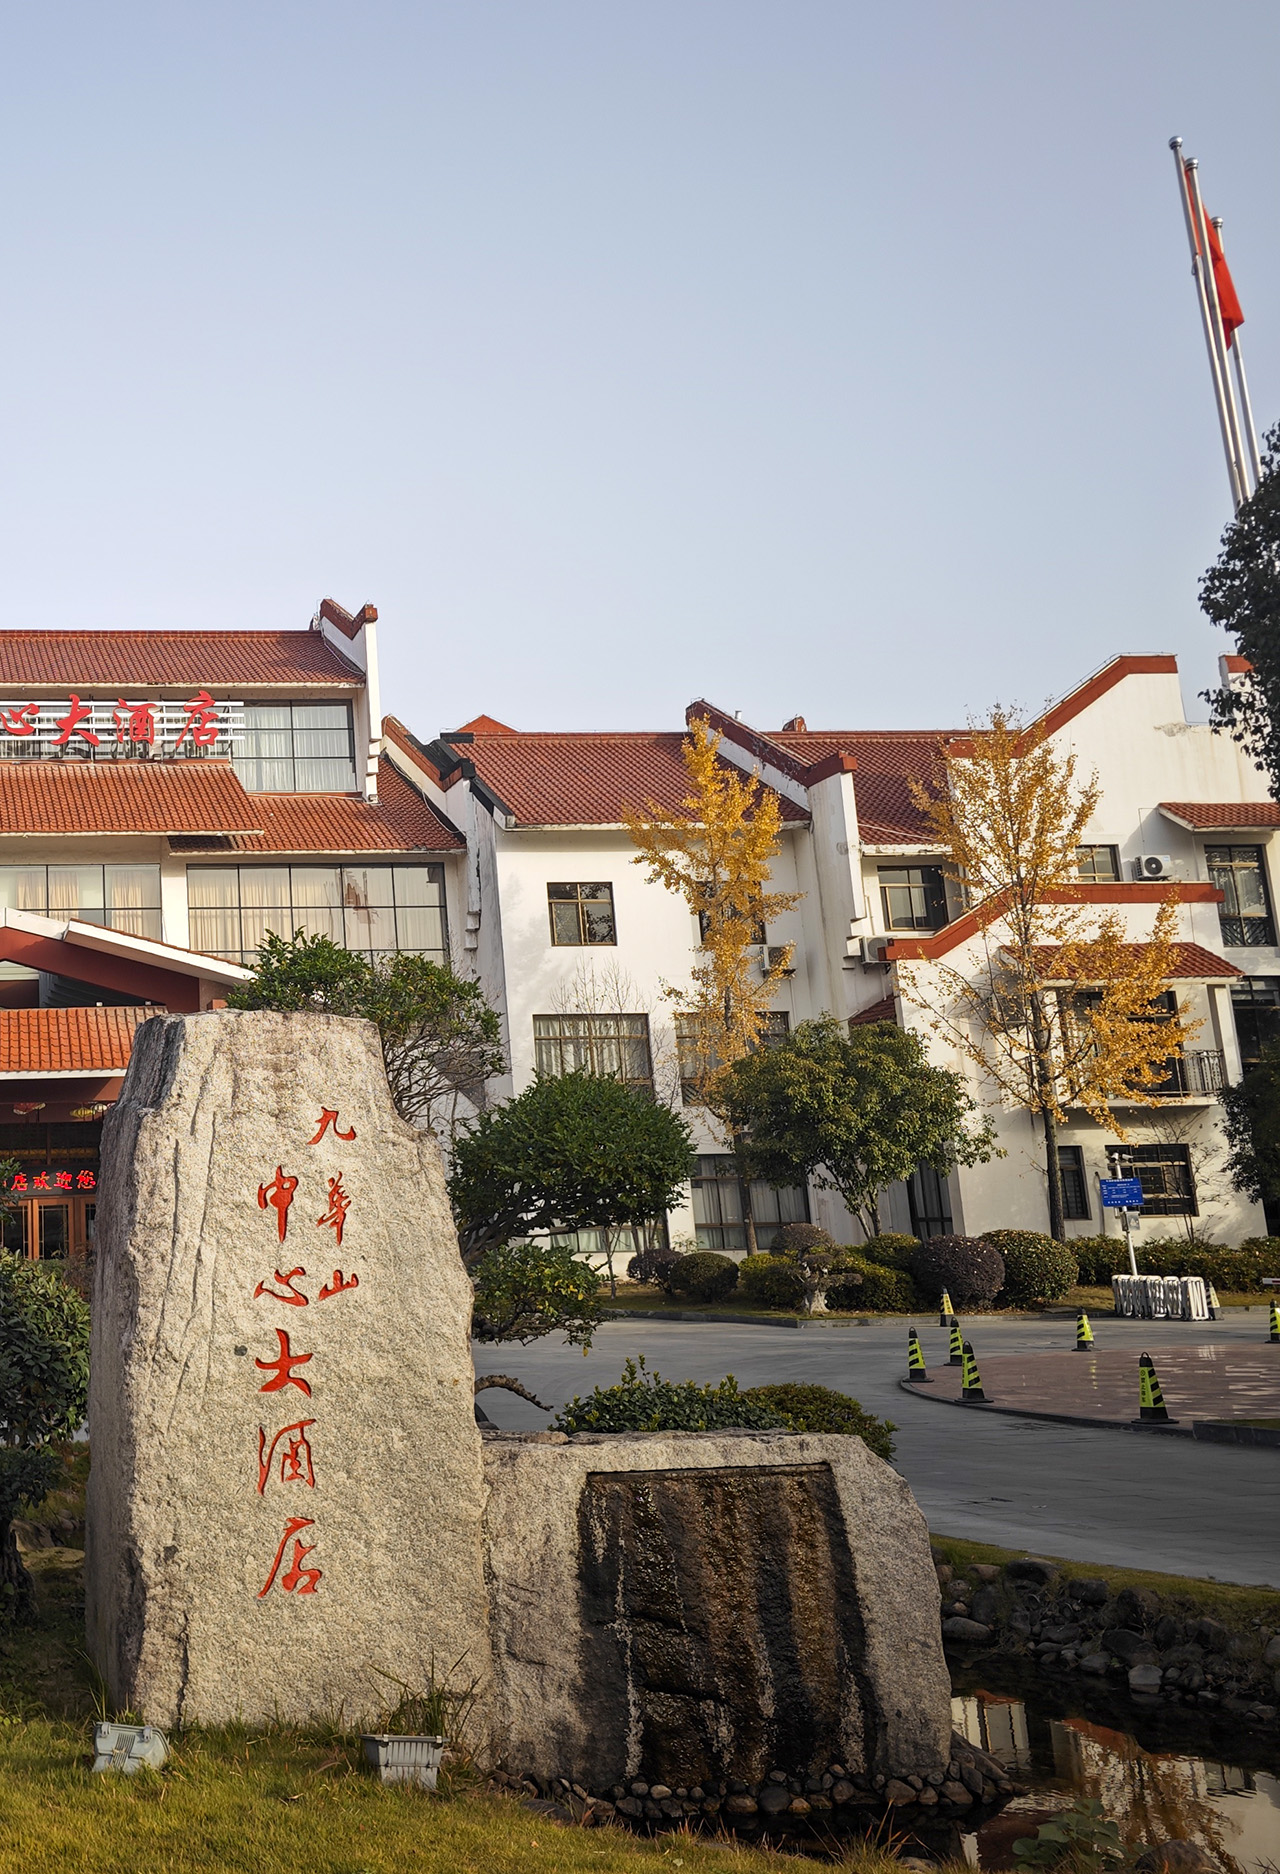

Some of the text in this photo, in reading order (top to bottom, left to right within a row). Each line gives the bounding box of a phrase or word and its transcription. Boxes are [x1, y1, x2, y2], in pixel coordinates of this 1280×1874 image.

[252, 1164, 322, 1600] 中心大酒店
